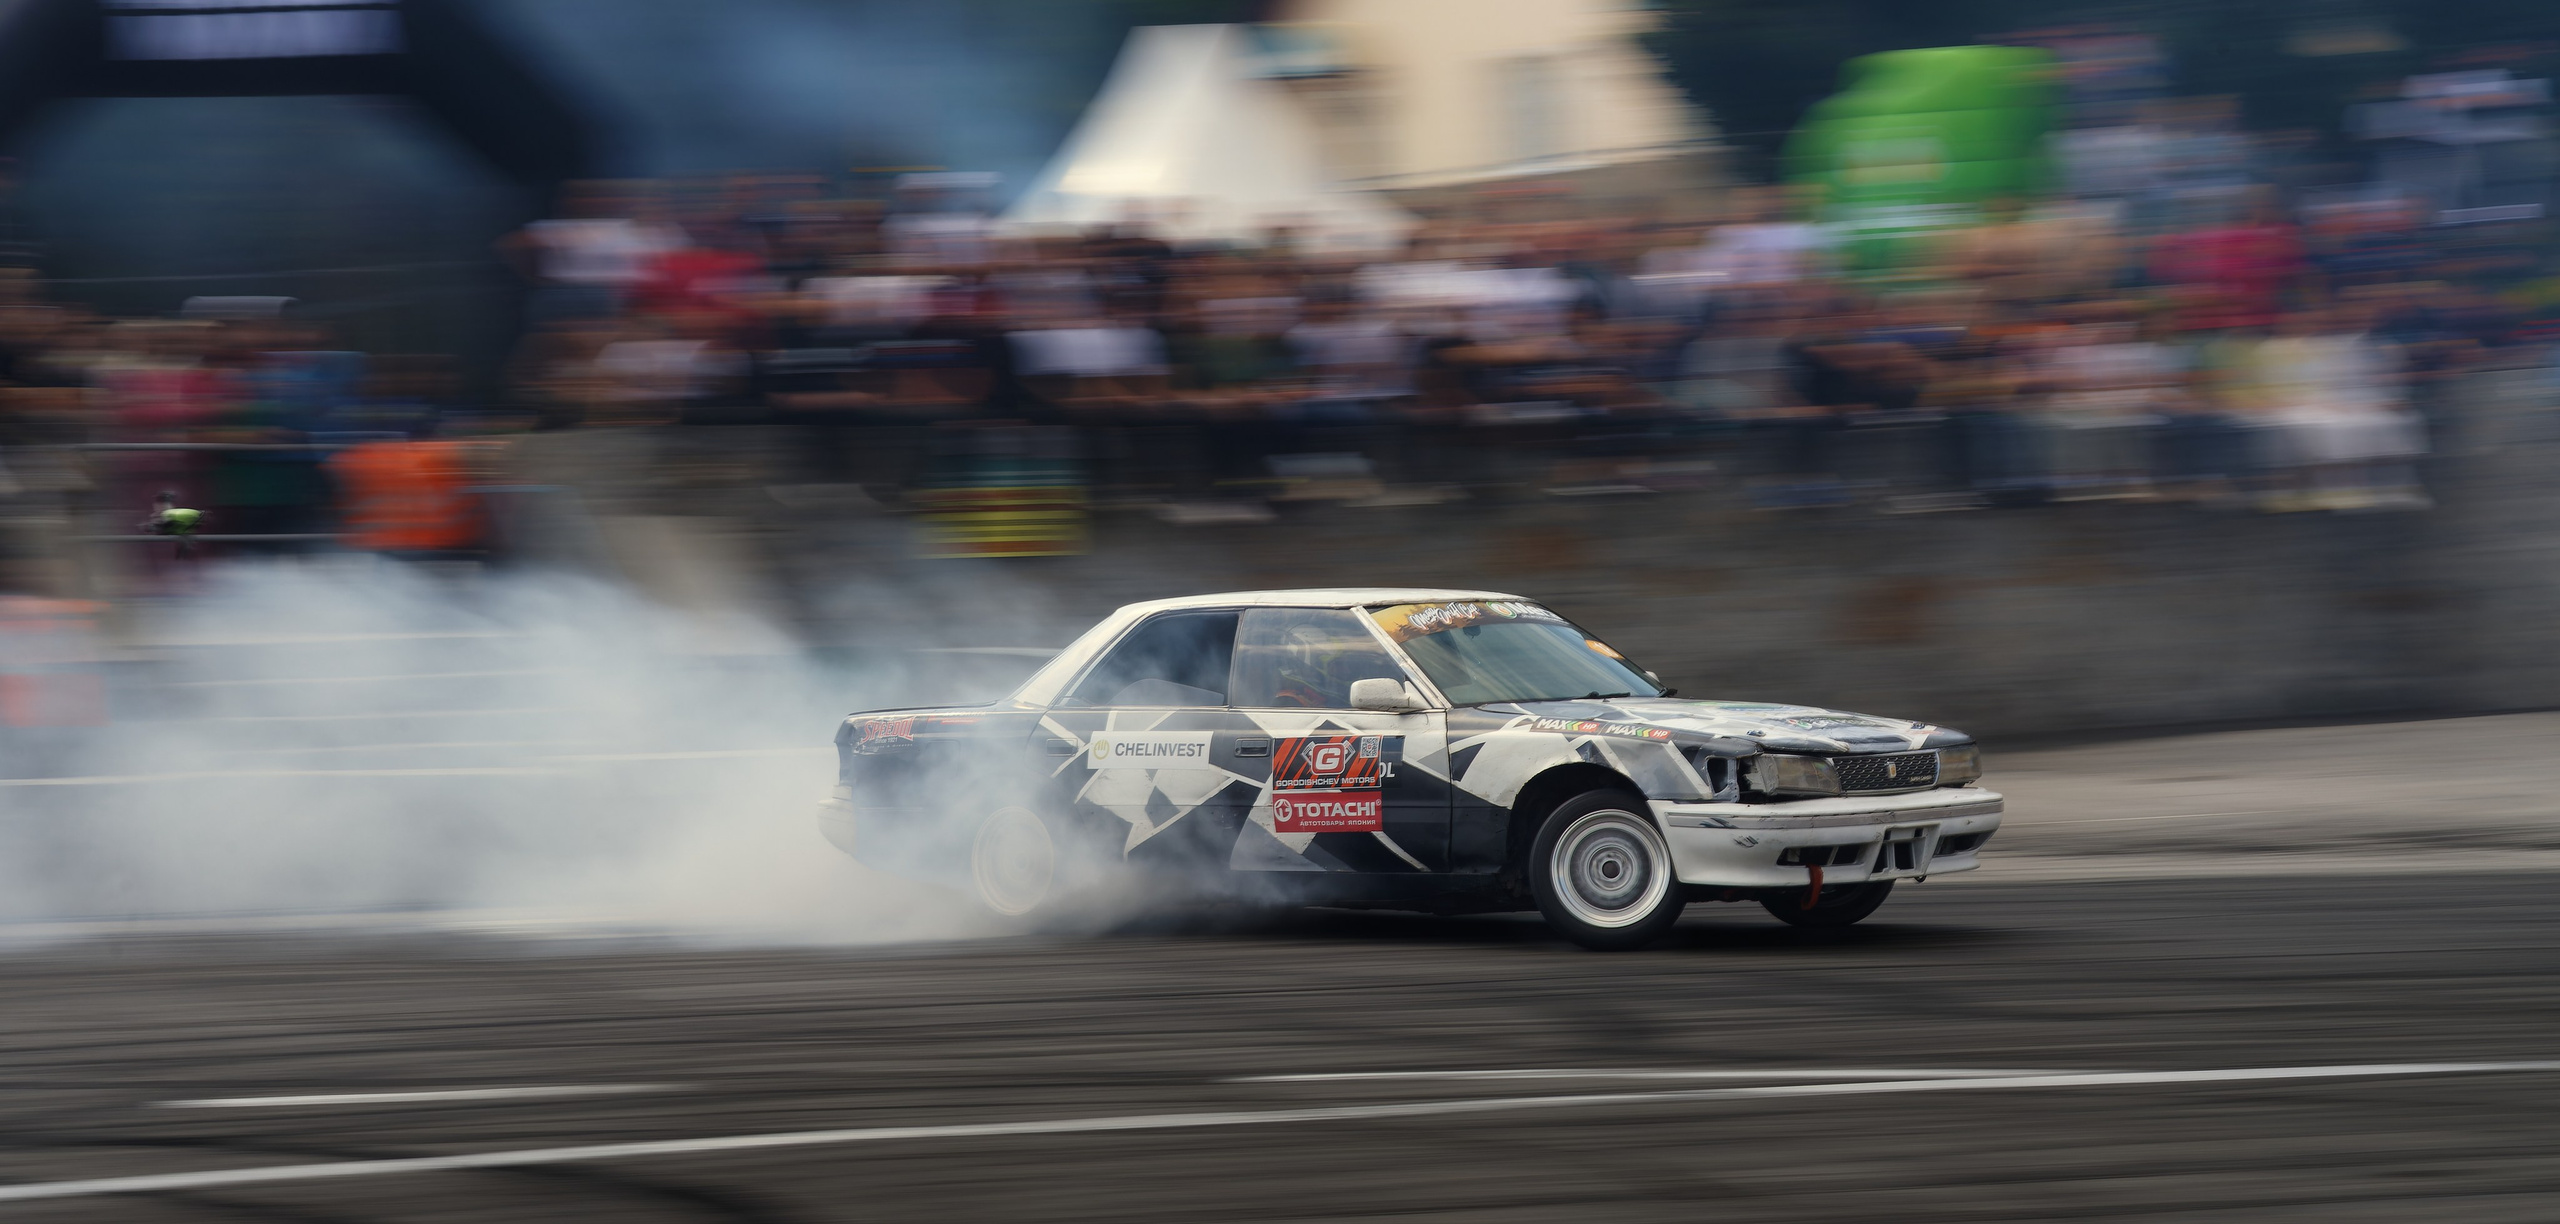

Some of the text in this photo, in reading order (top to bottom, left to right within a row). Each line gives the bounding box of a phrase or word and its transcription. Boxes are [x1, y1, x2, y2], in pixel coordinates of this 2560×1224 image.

[860, 716, 915, 745] SPEEDOL
[1537, 719, 1567, 730] MAX
[1606, 725, 1668, 738] MAX HP
[1114, 742, 1206, 757] CHELINVEST
[1315, 747, 1341, 770] G
[1276, 776, 1376, 787] GORODISHCHEV MOTORS
[1294, 802, 1375, 817] TOTACHI
